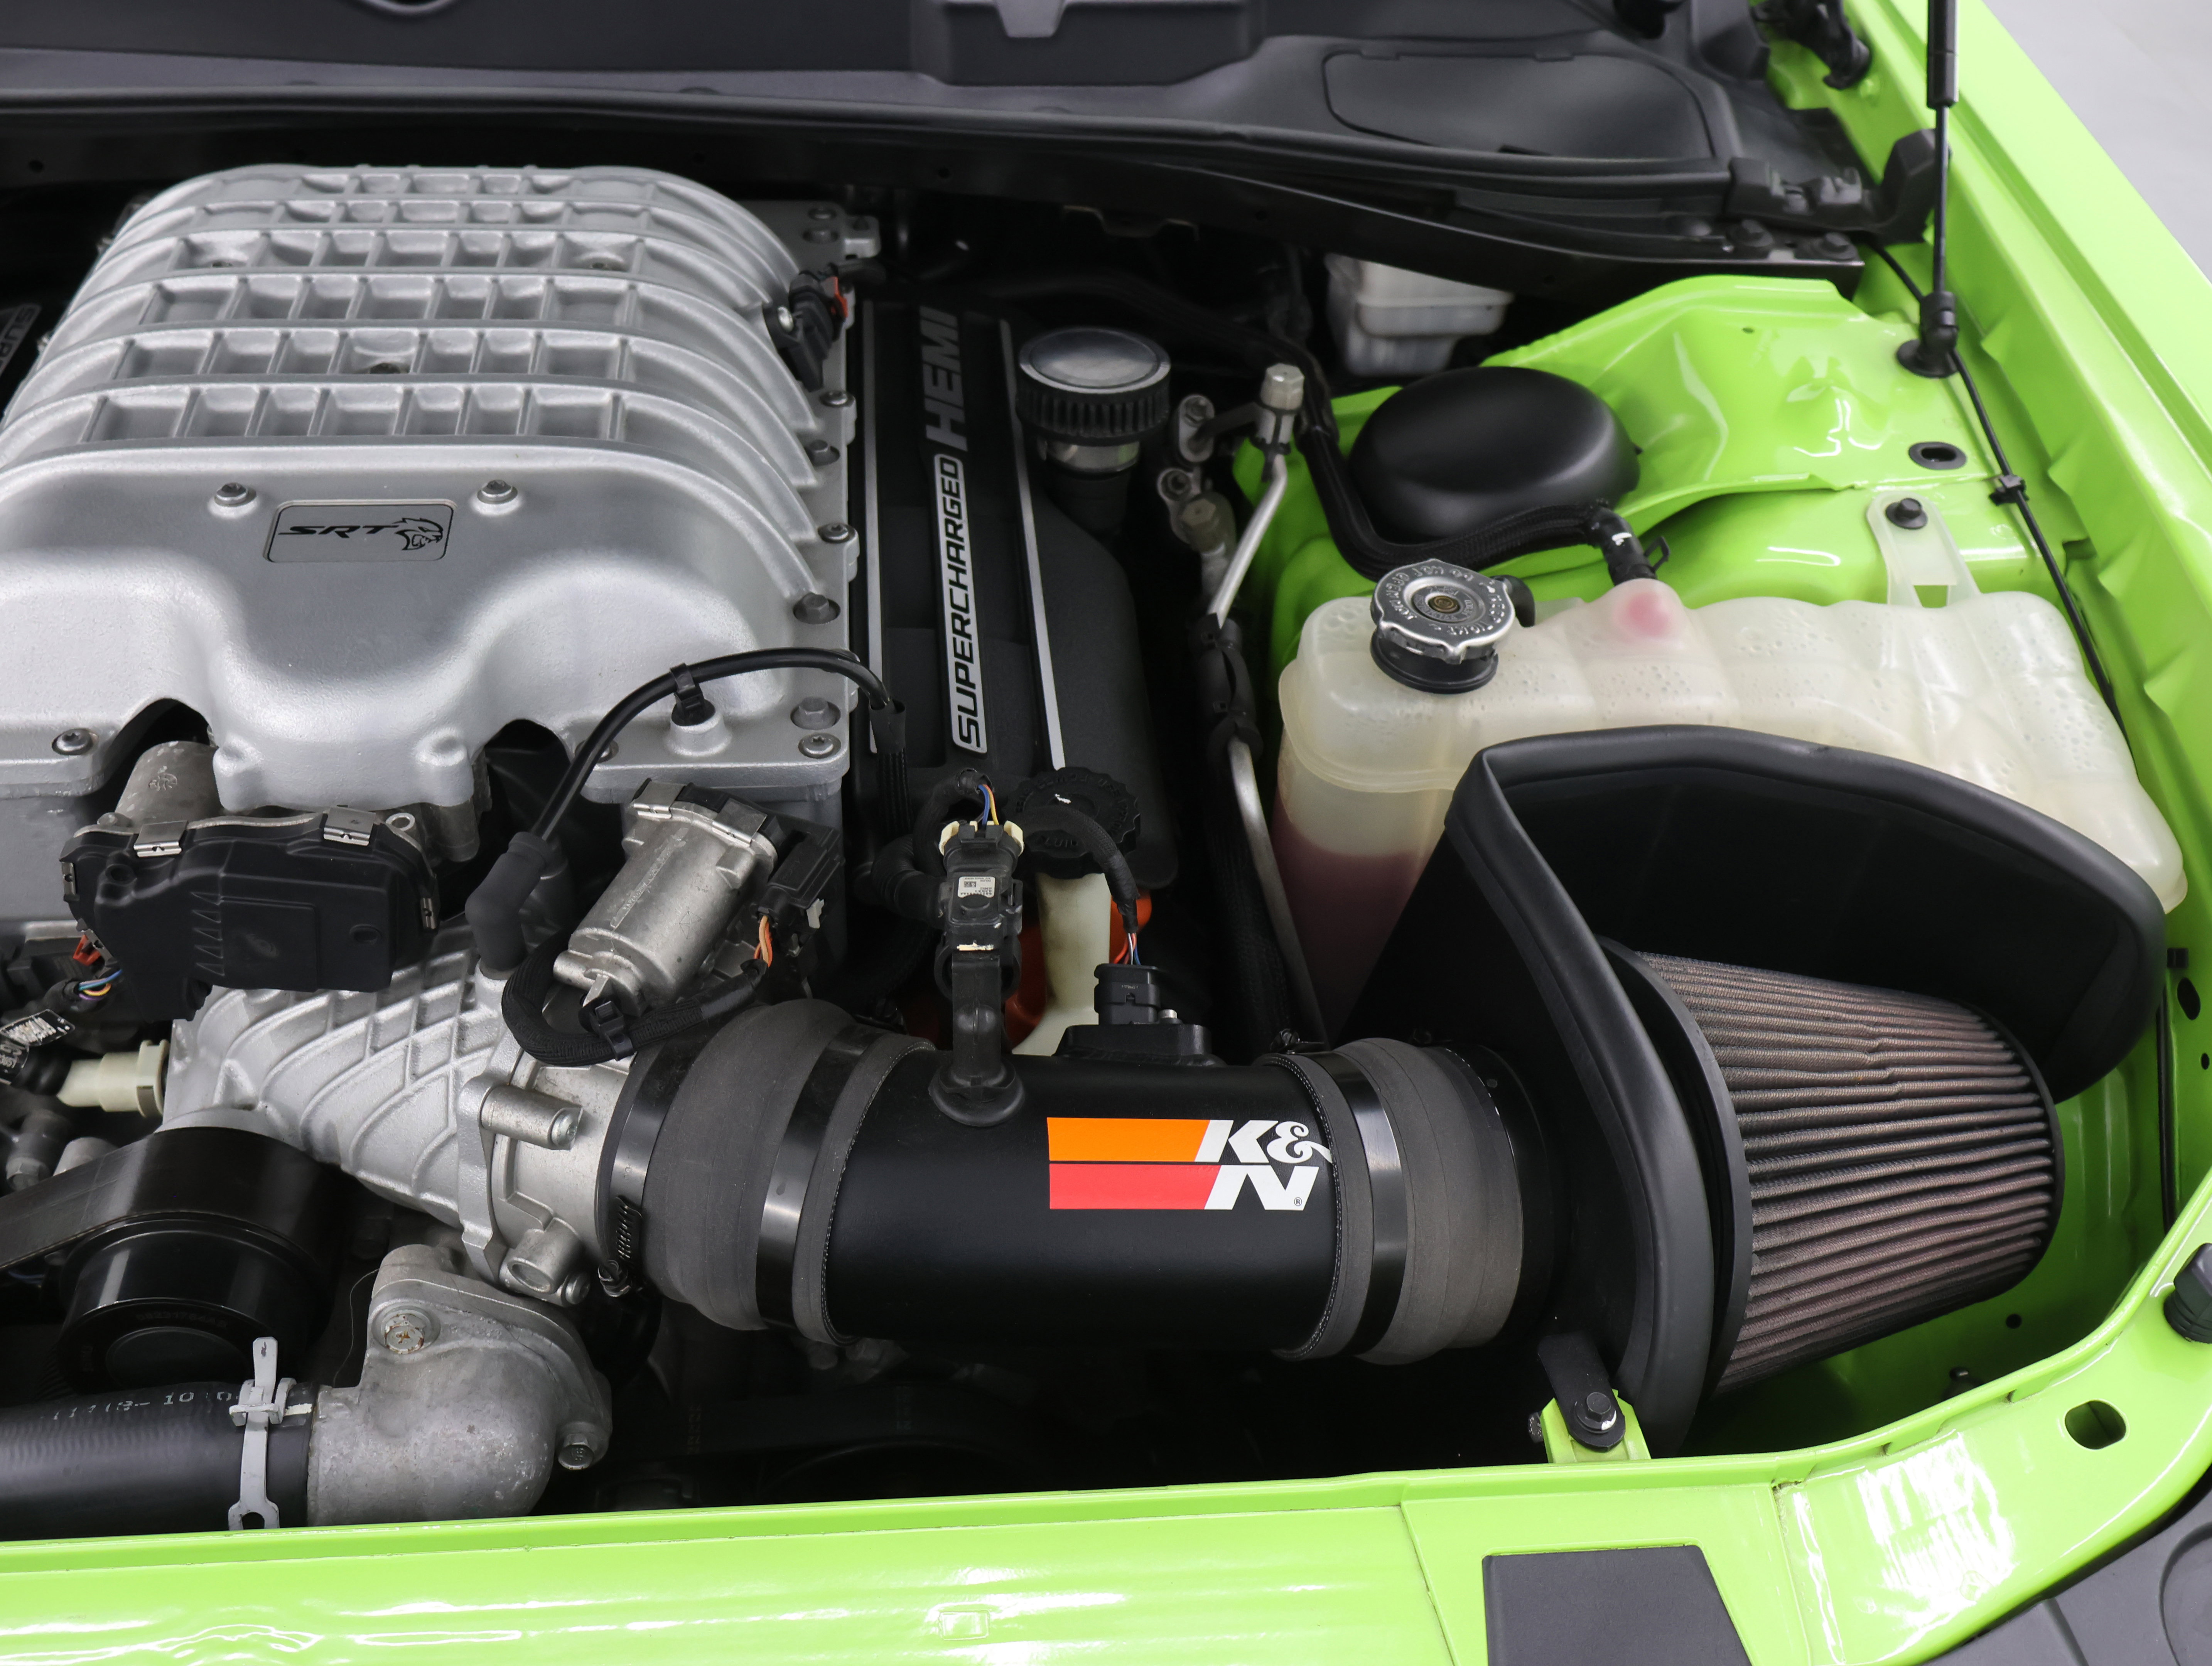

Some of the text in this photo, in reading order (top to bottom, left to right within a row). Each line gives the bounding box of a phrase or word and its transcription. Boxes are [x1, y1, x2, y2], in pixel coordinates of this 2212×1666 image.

[920, 306, 968, 452] HEMI
[278, 525, 400, 538] SRT
[940, 456, 982, 749] SUPERCHARGED
